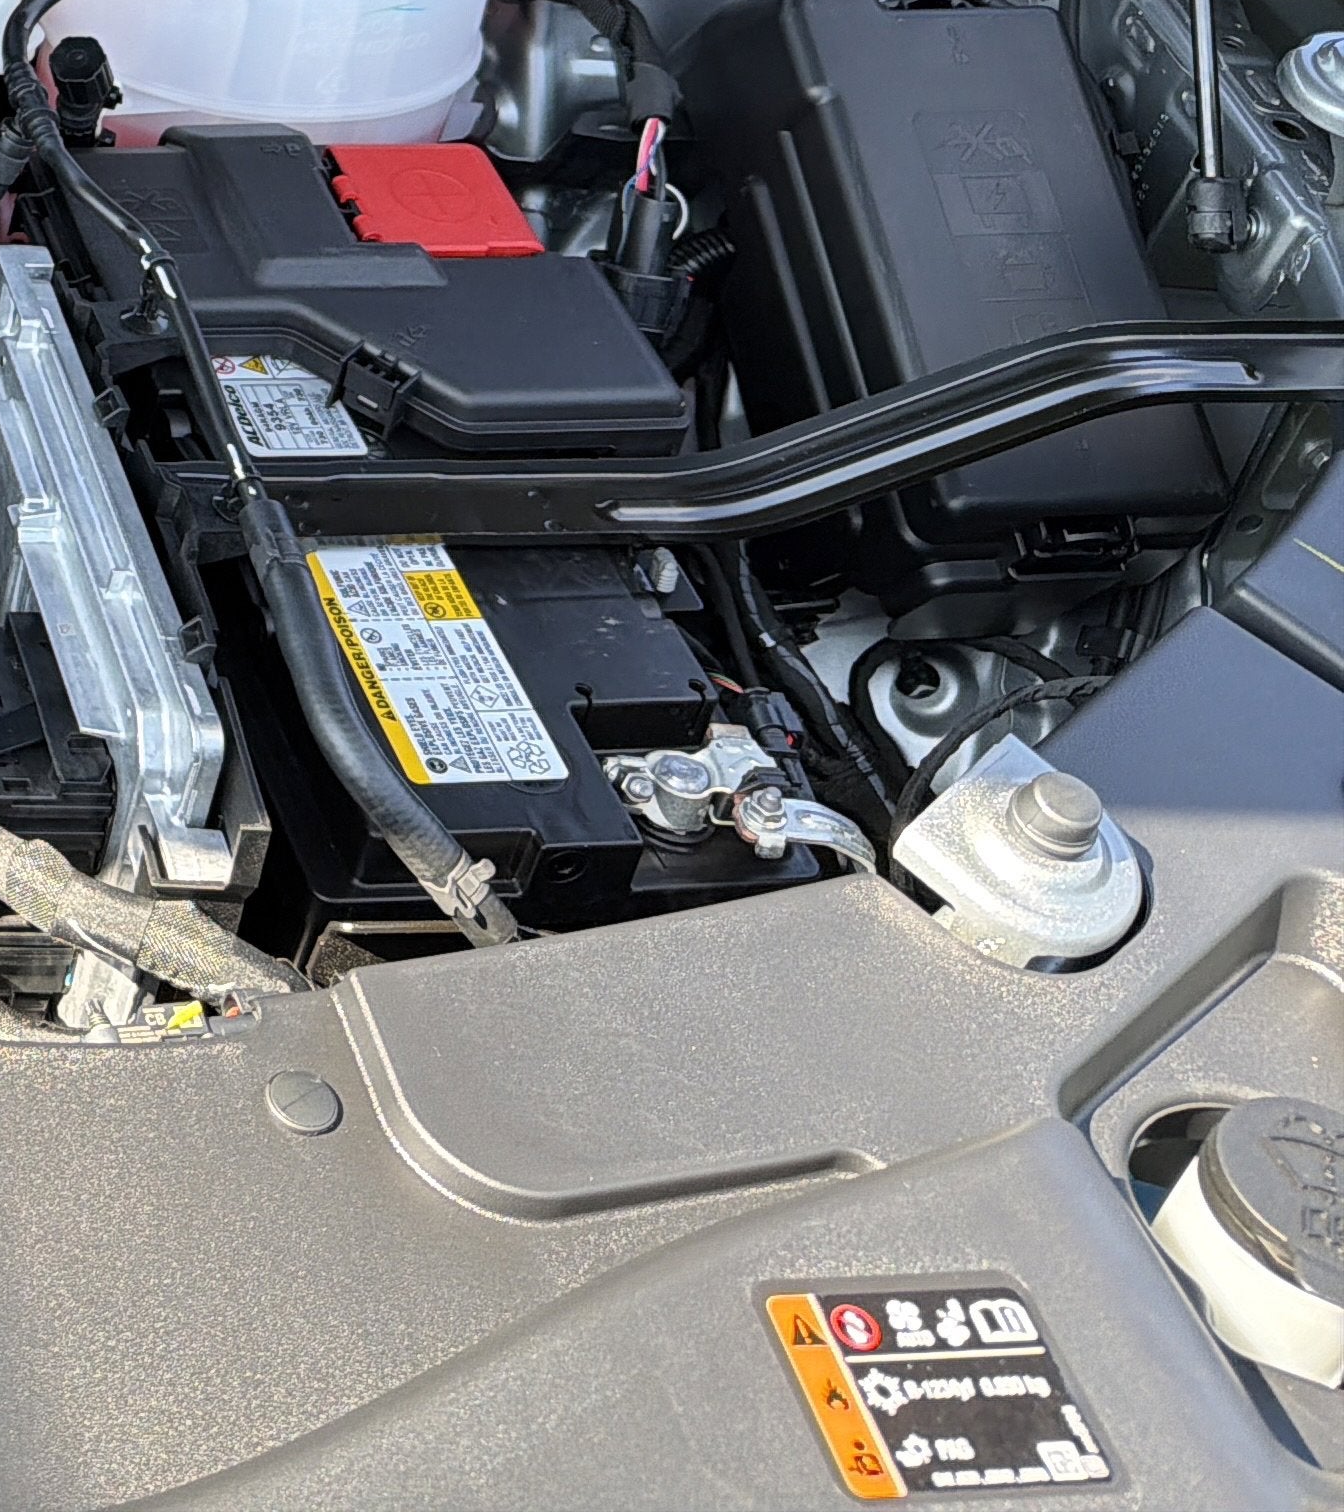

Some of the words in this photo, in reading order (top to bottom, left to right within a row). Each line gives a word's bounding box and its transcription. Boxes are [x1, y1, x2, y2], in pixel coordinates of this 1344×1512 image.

[218, 384, 264, 447] ACDelco
[261, 403, 287, 430] 9354
[322, 597, 391, 708] DANGER/POISON
[144, 1013, 167, 1026] CB
